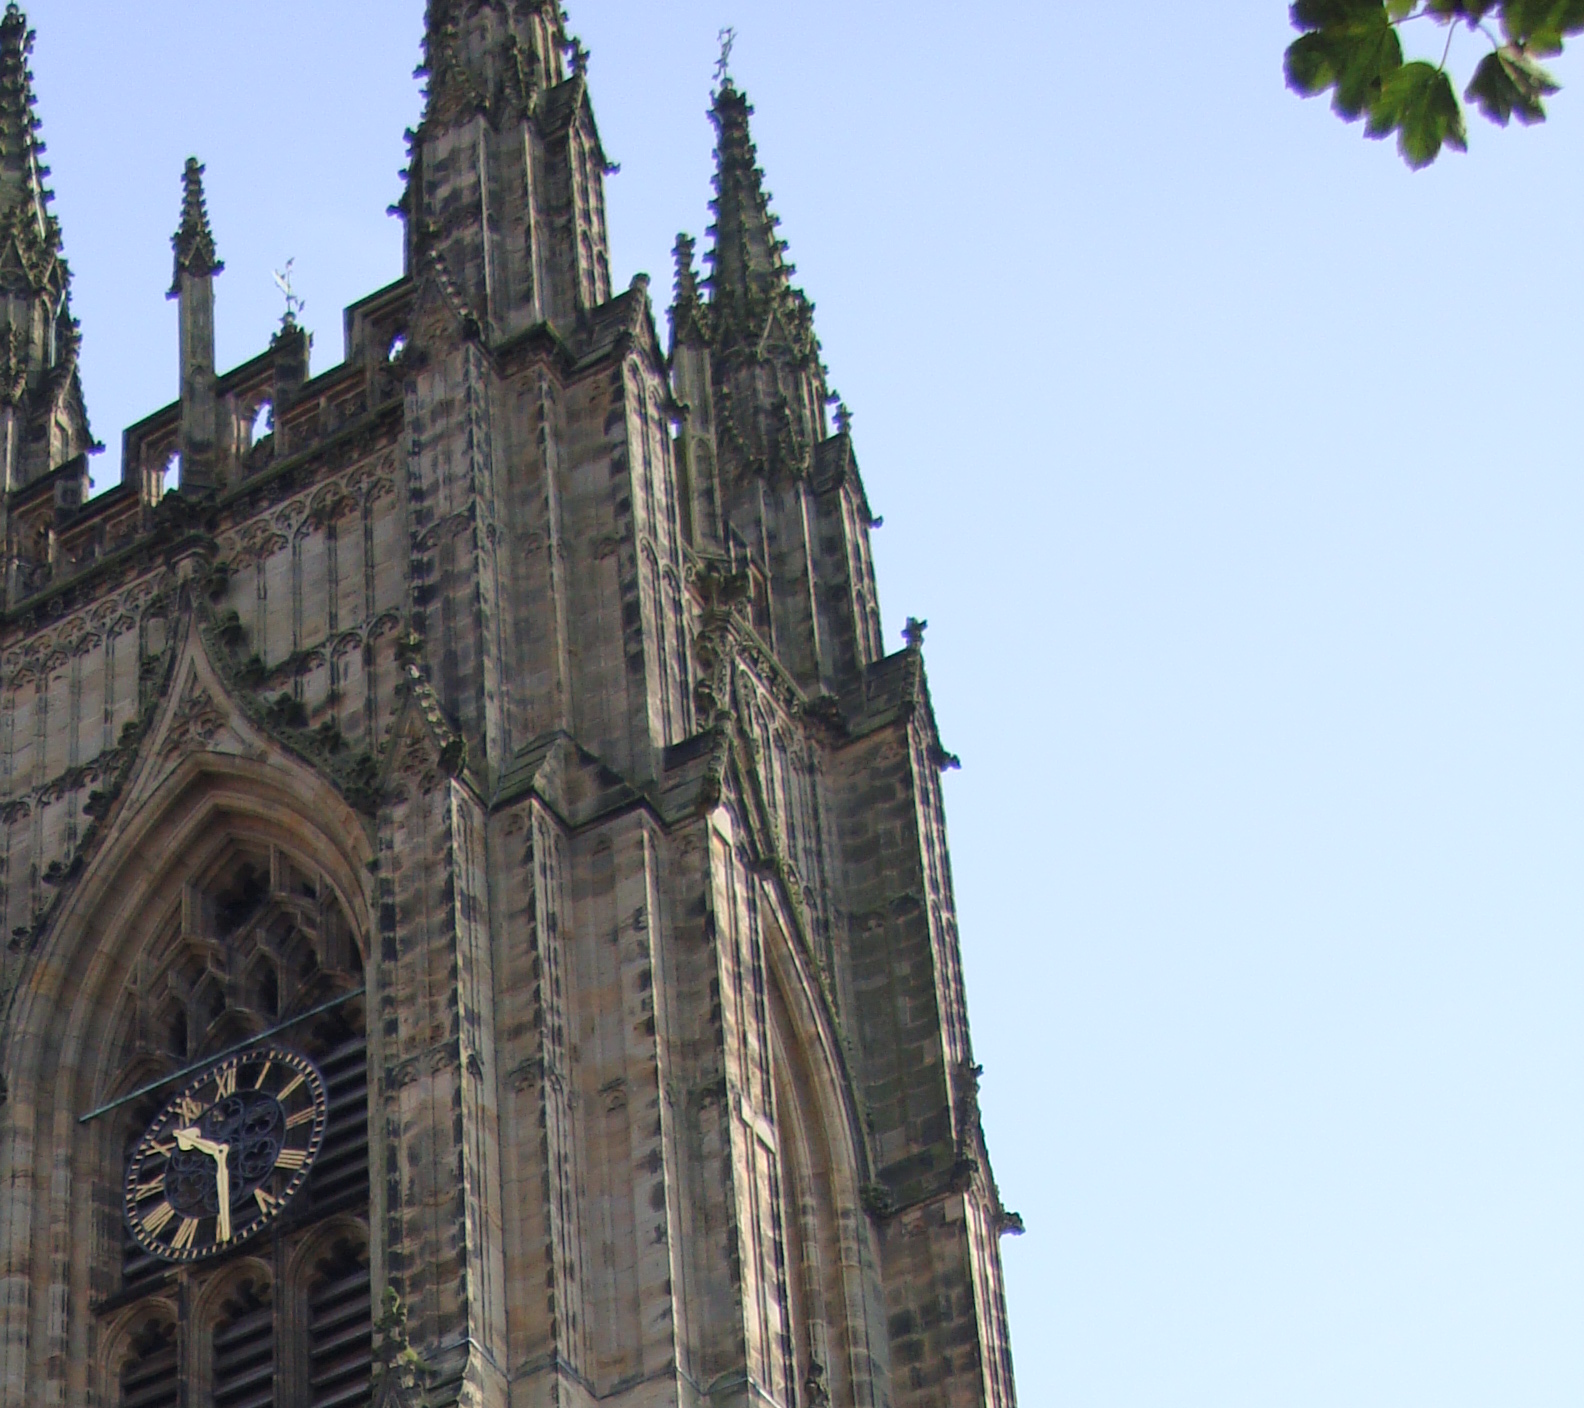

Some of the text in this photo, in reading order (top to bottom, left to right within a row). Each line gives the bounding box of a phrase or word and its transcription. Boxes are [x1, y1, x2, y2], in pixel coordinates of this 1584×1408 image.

[214, 1067, 236, 1103] XII
[285, 1105, 316, 1130] III
[145, 1140, 177, 1158] X
[253, 1187, 277, 1214] V
